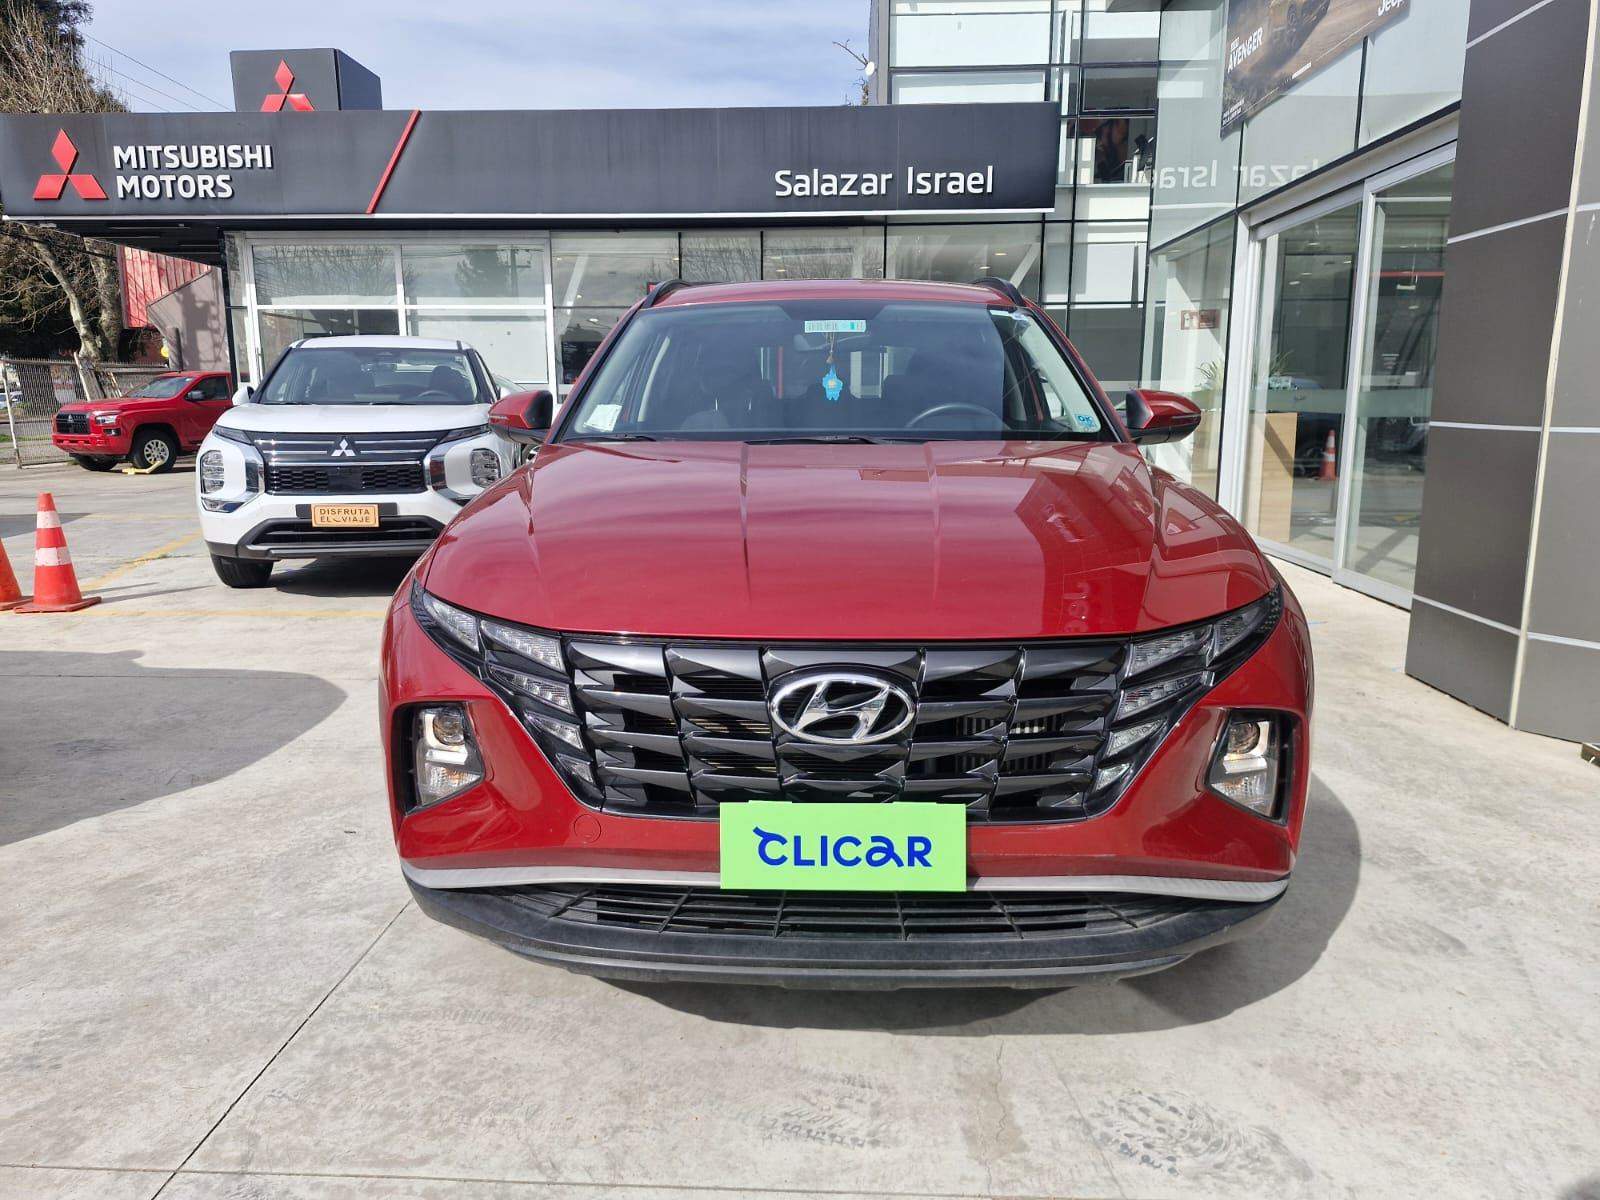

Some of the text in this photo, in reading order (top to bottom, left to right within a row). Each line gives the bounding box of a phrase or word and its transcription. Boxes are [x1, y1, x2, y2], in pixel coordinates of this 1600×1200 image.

[1228, 27, 1262, 74] AVENGER
[113, 145, 273, 169] MITSUBISHI
[116, 175, 233, 198] MOTORS
[774, 165, 994, 197] Salazar Israel
